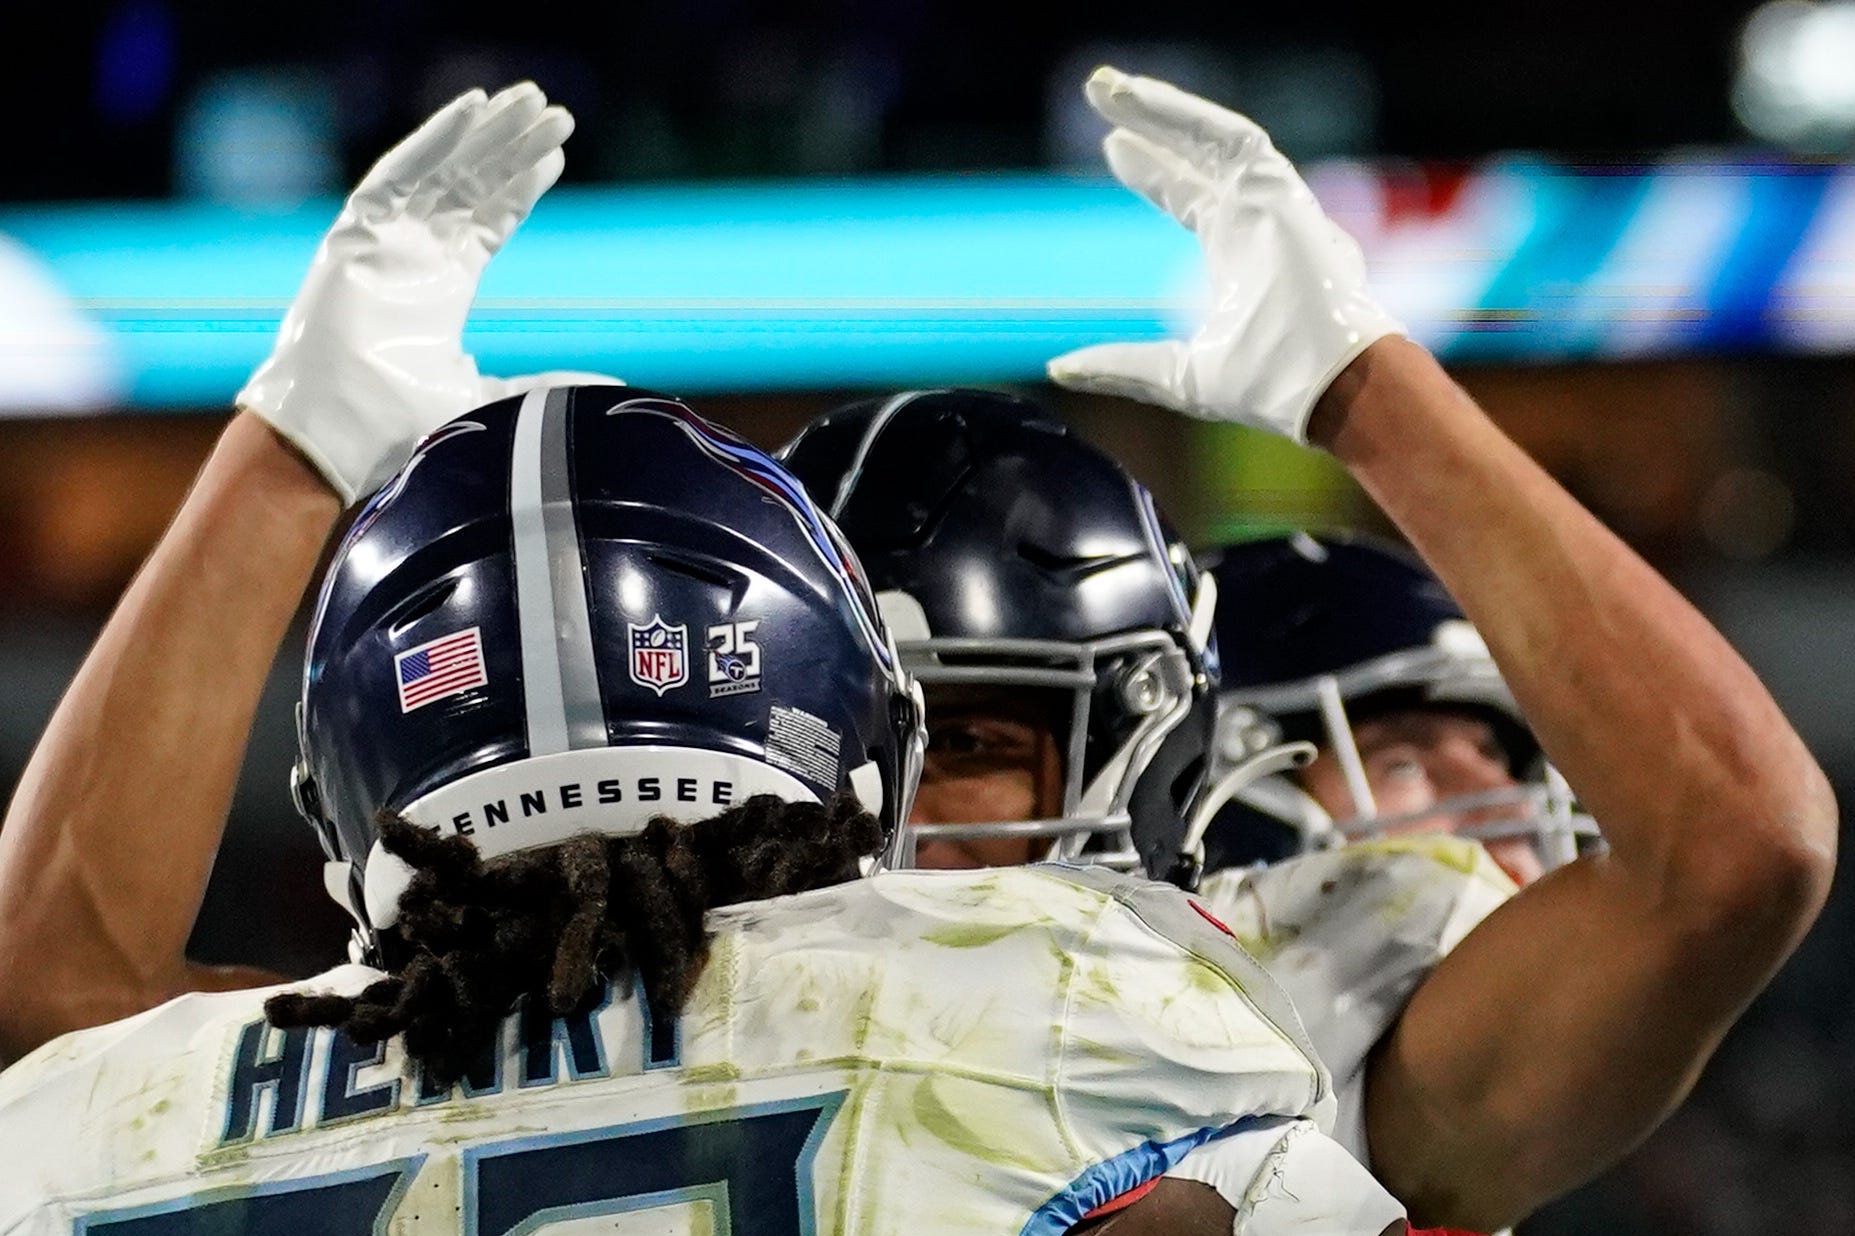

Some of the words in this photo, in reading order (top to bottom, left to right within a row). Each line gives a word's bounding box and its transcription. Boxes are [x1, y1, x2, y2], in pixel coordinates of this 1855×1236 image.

[636, 651, 681, 682] NFL
[707, 619, 761, 683] 25
[430, 777, 733, 837] ENNESSEE
